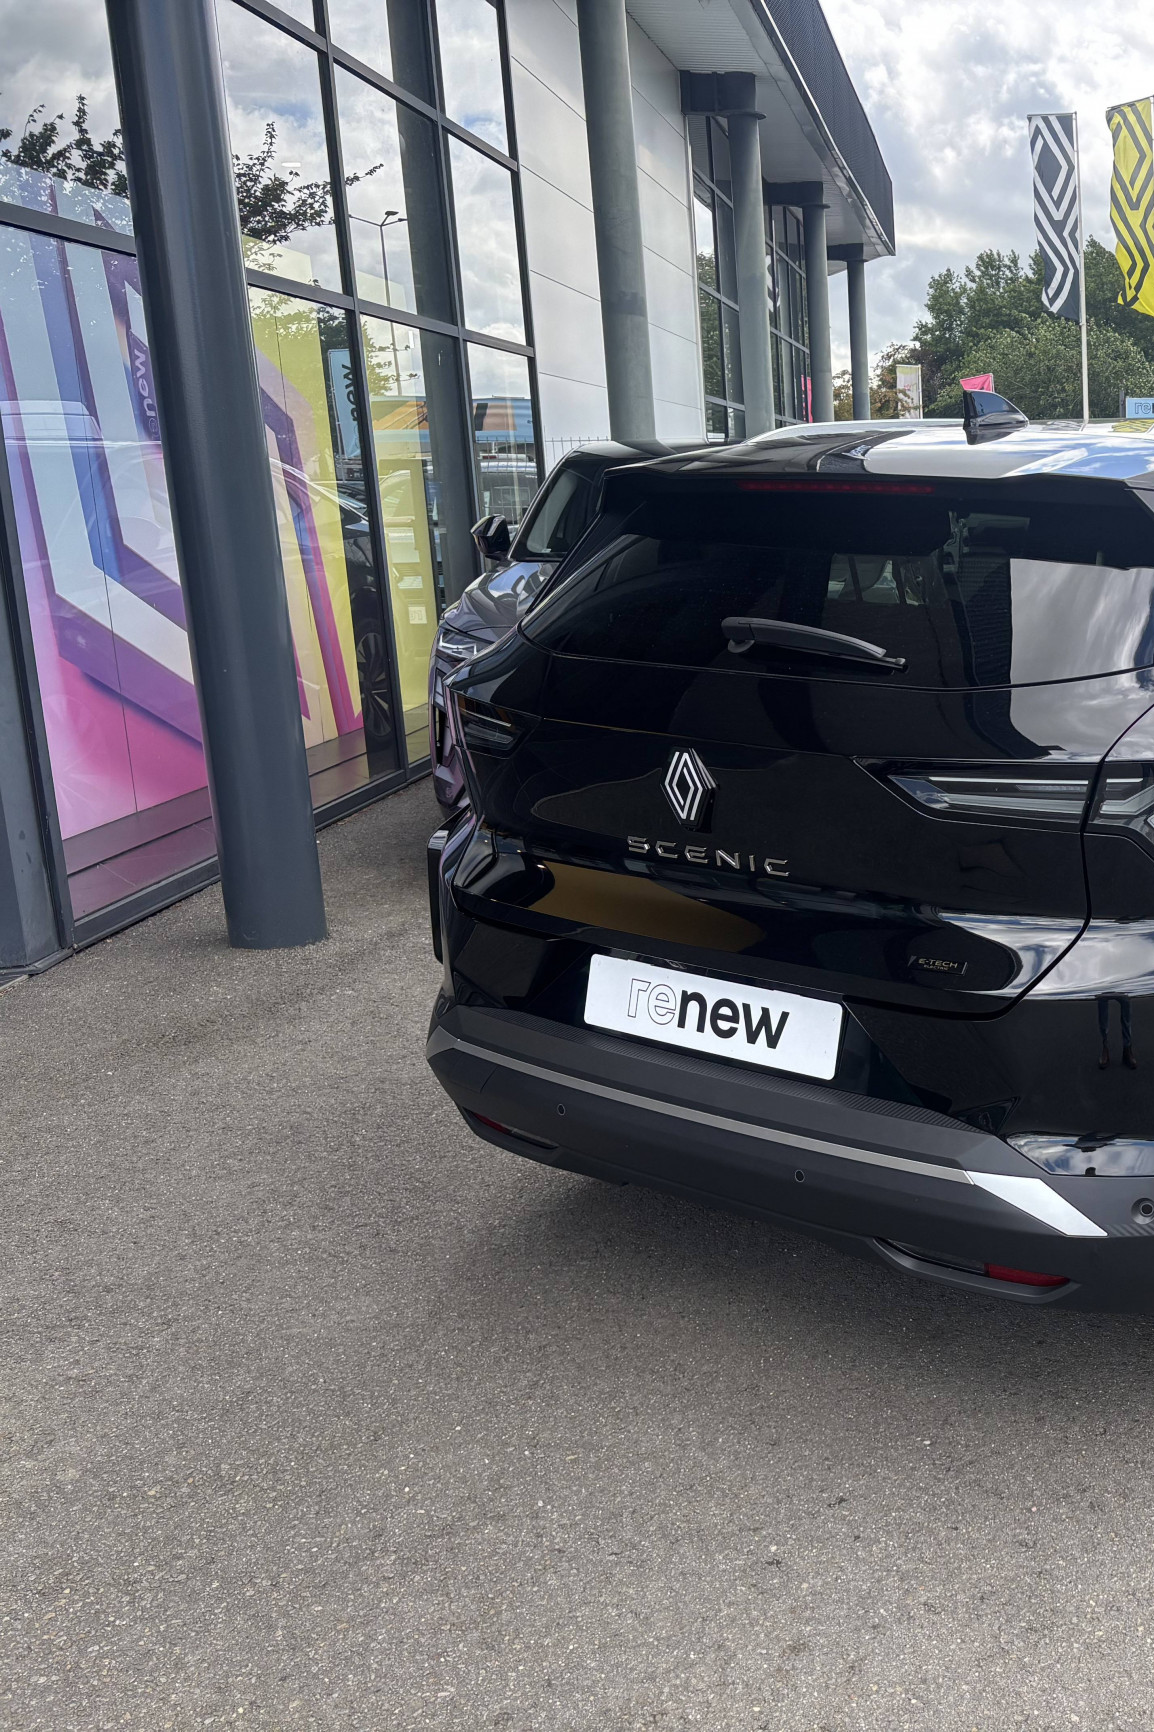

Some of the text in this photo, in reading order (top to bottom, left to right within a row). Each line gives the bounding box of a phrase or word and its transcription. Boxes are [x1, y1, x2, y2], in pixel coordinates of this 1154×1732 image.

[626, 835, 791, 877] SCENIC
[918, 958, 958, 969] E-TECH
[626, 977, 790, 1050] renew
